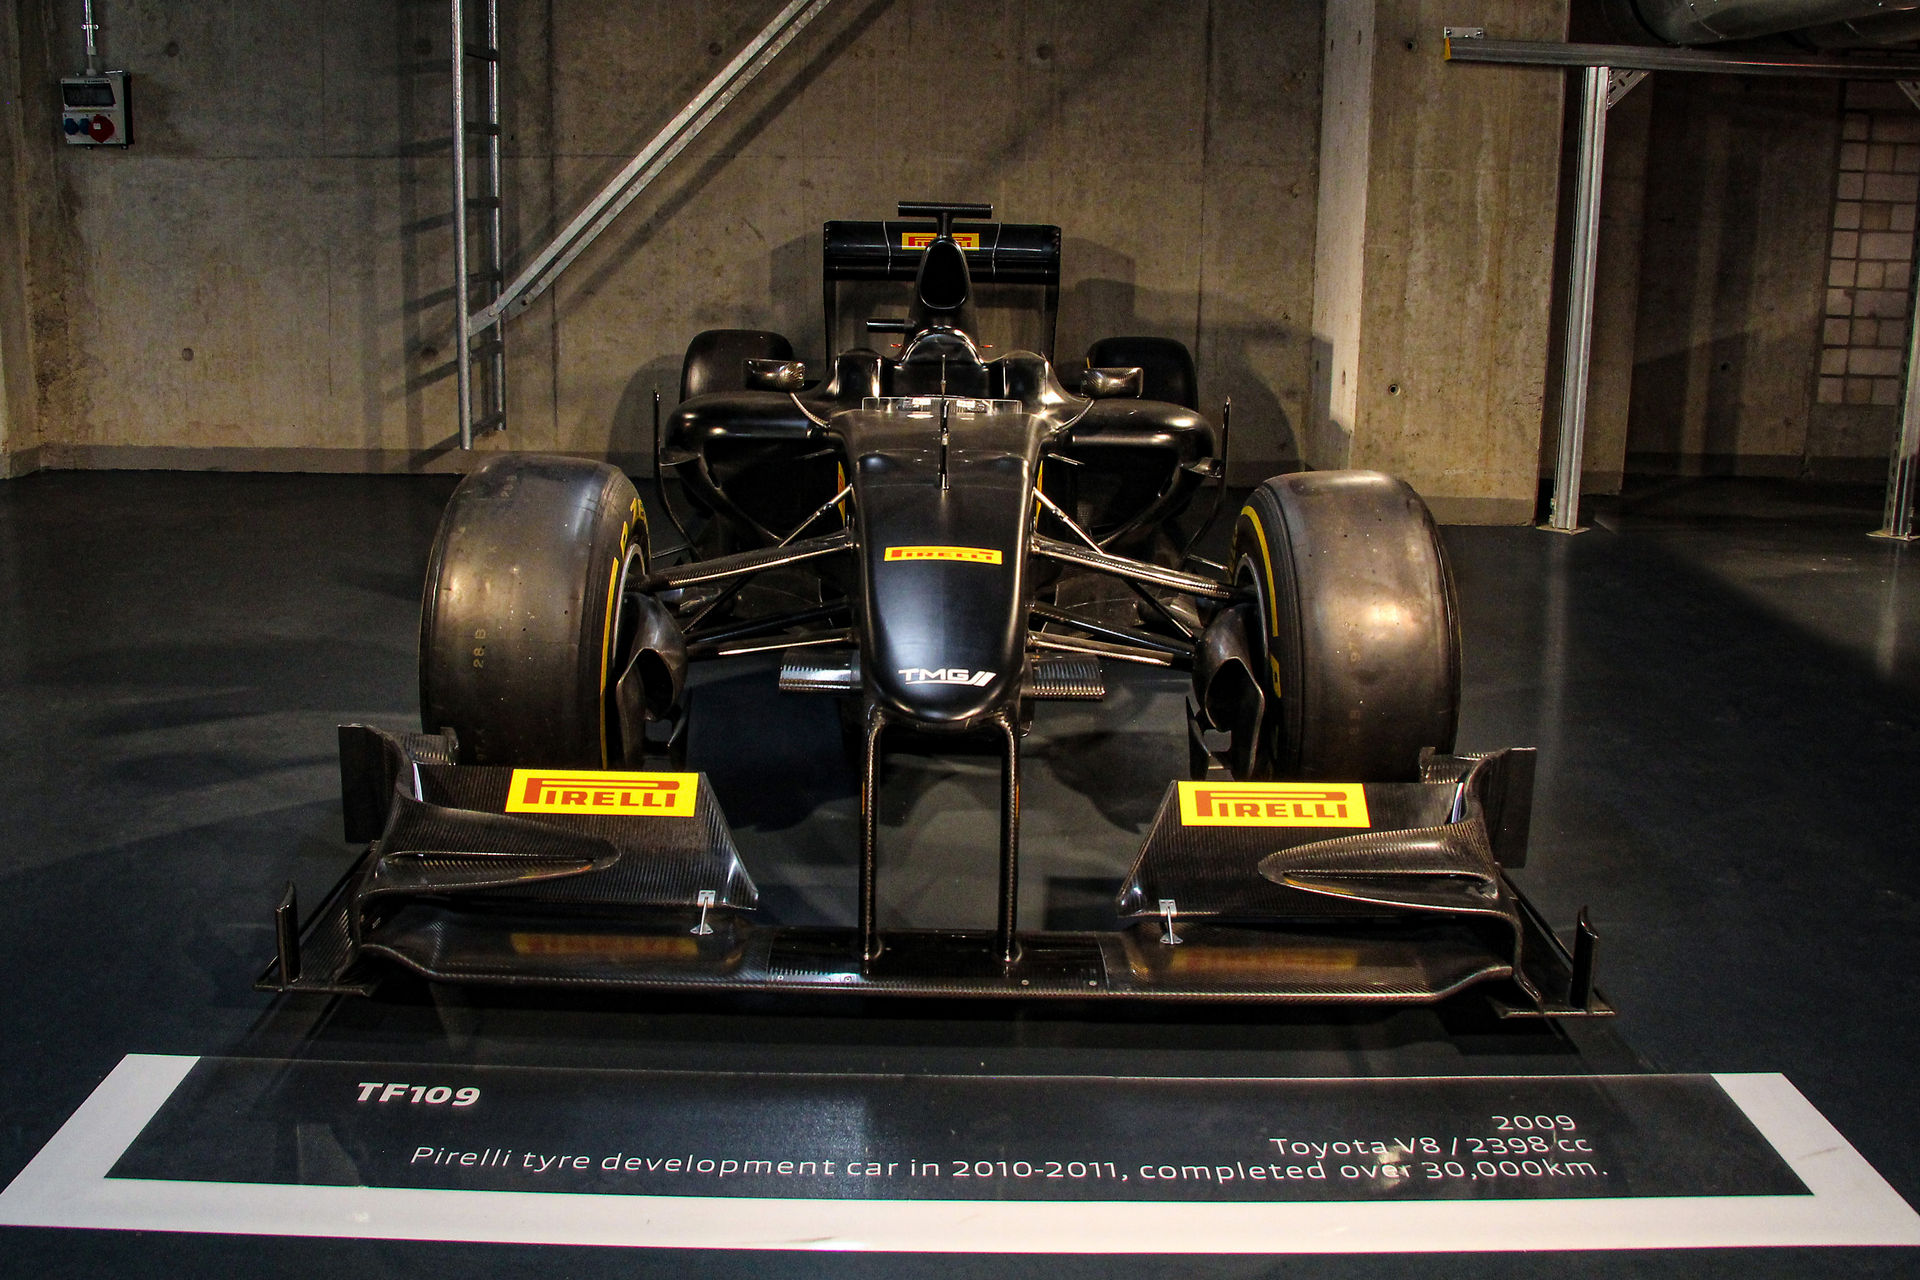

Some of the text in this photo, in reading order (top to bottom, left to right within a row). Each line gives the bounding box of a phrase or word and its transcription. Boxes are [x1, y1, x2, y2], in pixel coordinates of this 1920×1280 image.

[898, 668, 971, 683] TMG
[523, 778, 680, 808] PIRELLI
[1195, 790, 1347, 818] PIRELLI
[357, 1082, 481, 1107] TF109
[1492, 1115, 1576, 1131] 2009
[1269, 1136, 1592, 1159] Toyota V8 / 2398 cc
[410, 1146, 1608, 1184] Pirelli tyre development car in 2010-2011, completed over 30,000km.
